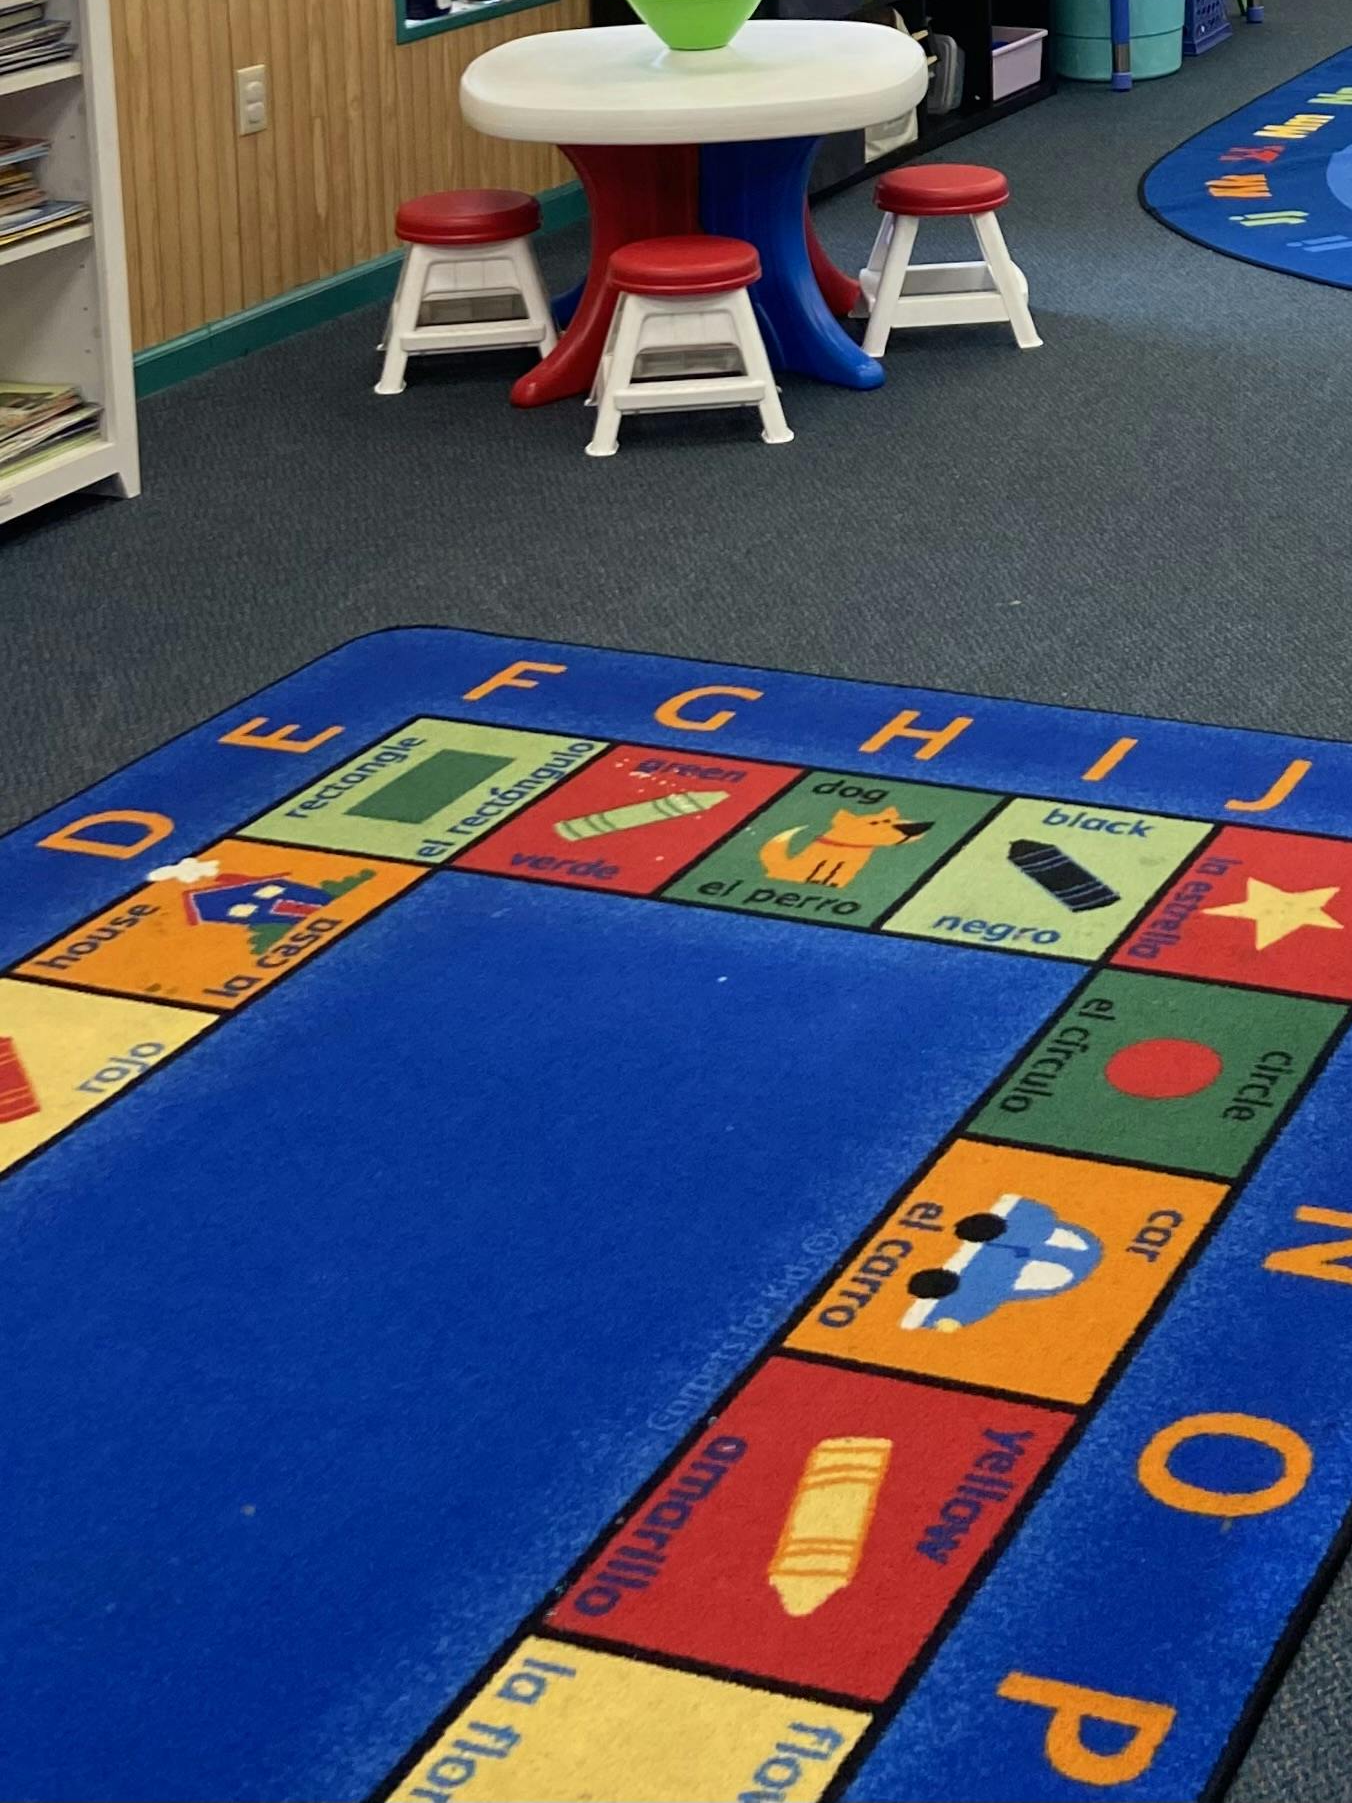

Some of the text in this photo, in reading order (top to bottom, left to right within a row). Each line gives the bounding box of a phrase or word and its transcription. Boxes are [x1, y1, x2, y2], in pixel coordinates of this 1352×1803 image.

[463, 661, 568, 701] F
[218, 716, 346, 754] E
[654, 685, 764, 732] G
[858, 709, 974, 761] H
[284, 733, 428, 821] rectangle
[636, 758, 747, 784] green
[1081, 737, 1139, 782] I
[416, 739, 595, 859] el rectángulo
[812, 777, 887, 807] dog
[1225, 760, 1312, 813] J
[35, 810, 174, 860] D
[1041, 806, 1154, 840] black
[509, 849, 620, 882] verde
[698, 877, 862, 921] el perro
[1127, 856, 1244, 959] la estrella
[35, 901, 160, 972] house
[932, 910, 1061, 946] negro
[204, 916, 343, 1000] la casa
[74, 1039, 166, 1097] rojo
[1000, 997, 1116, 1116] el círculo
[1223, 1050, 1293, 1123] circle
[899, 1200, 945, 1236] el
[1126, 1209, 1182, 1263] car
[818, 1237, 914, 1331] carro
[1138, 1411, 1312, 1518] O
[917, 1426, 1034, 1565] yellow
[572, 1432, 749, 1619] amarillo
[496, 1658, 577, 1704] la
[996, 1670, 1176, 1789] P
[738, 1721, 844, 1803] flo
